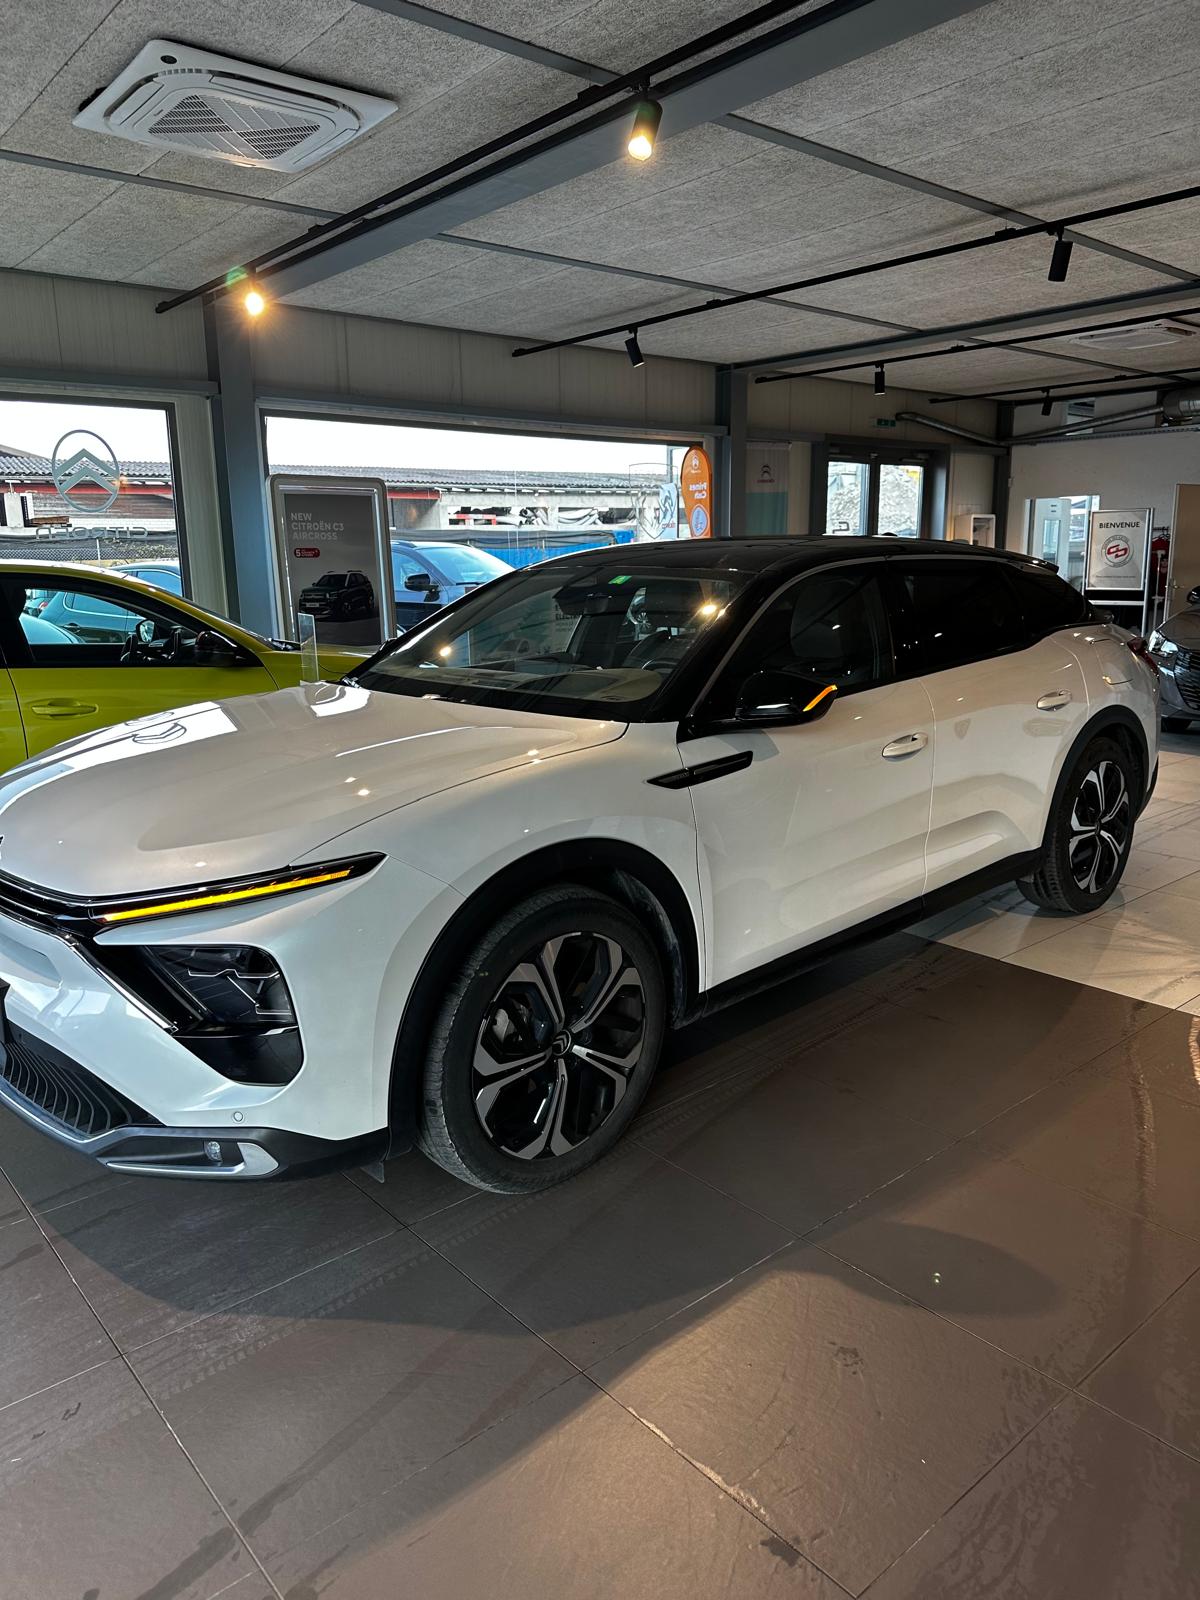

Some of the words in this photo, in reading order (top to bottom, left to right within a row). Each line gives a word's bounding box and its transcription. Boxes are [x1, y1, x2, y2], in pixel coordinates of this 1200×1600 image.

[290, 512, 313, 521] NEW
[291, 520, 331, 531] CITROËN
[332, 523, 345, 531] C3
[1099, 521, 1141, 529] BIENVENUE
[292, 532, 338, 541] AIRCROSS
[295, 549, 301, 557] 5
